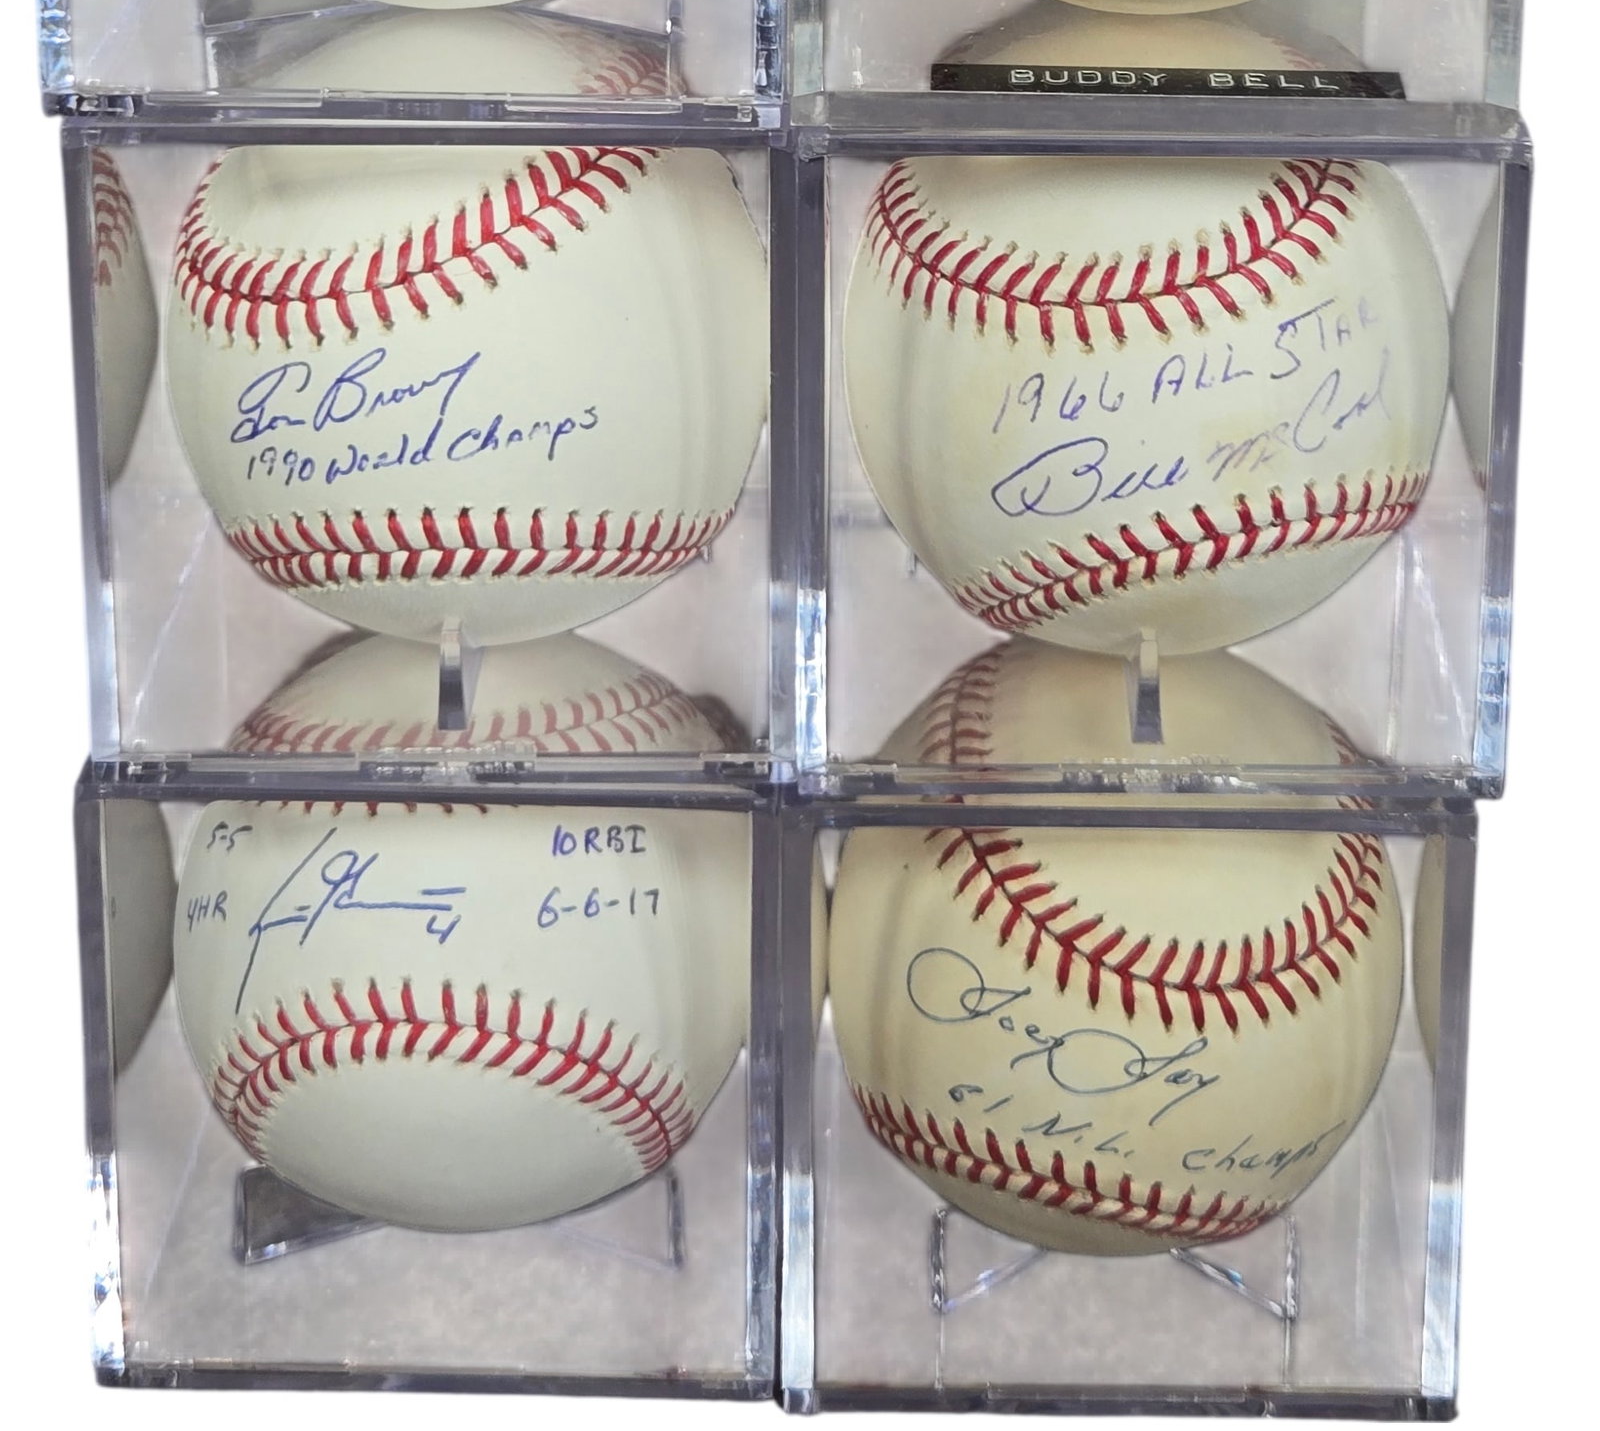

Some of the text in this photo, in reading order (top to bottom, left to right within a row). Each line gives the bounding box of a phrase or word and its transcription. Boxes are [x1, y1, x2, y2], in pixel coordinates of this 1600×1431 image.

[1009, 68, 1341, 91] BUDDY BELL
[992, 297, 1381, 434] 1966 ALL STAR
[248, 445, 316, 486] 1990
[325, 417, 443, 484] World
[584, 824, 647, 855] RBI
[537, 886, 660, 929] 6-6-17
